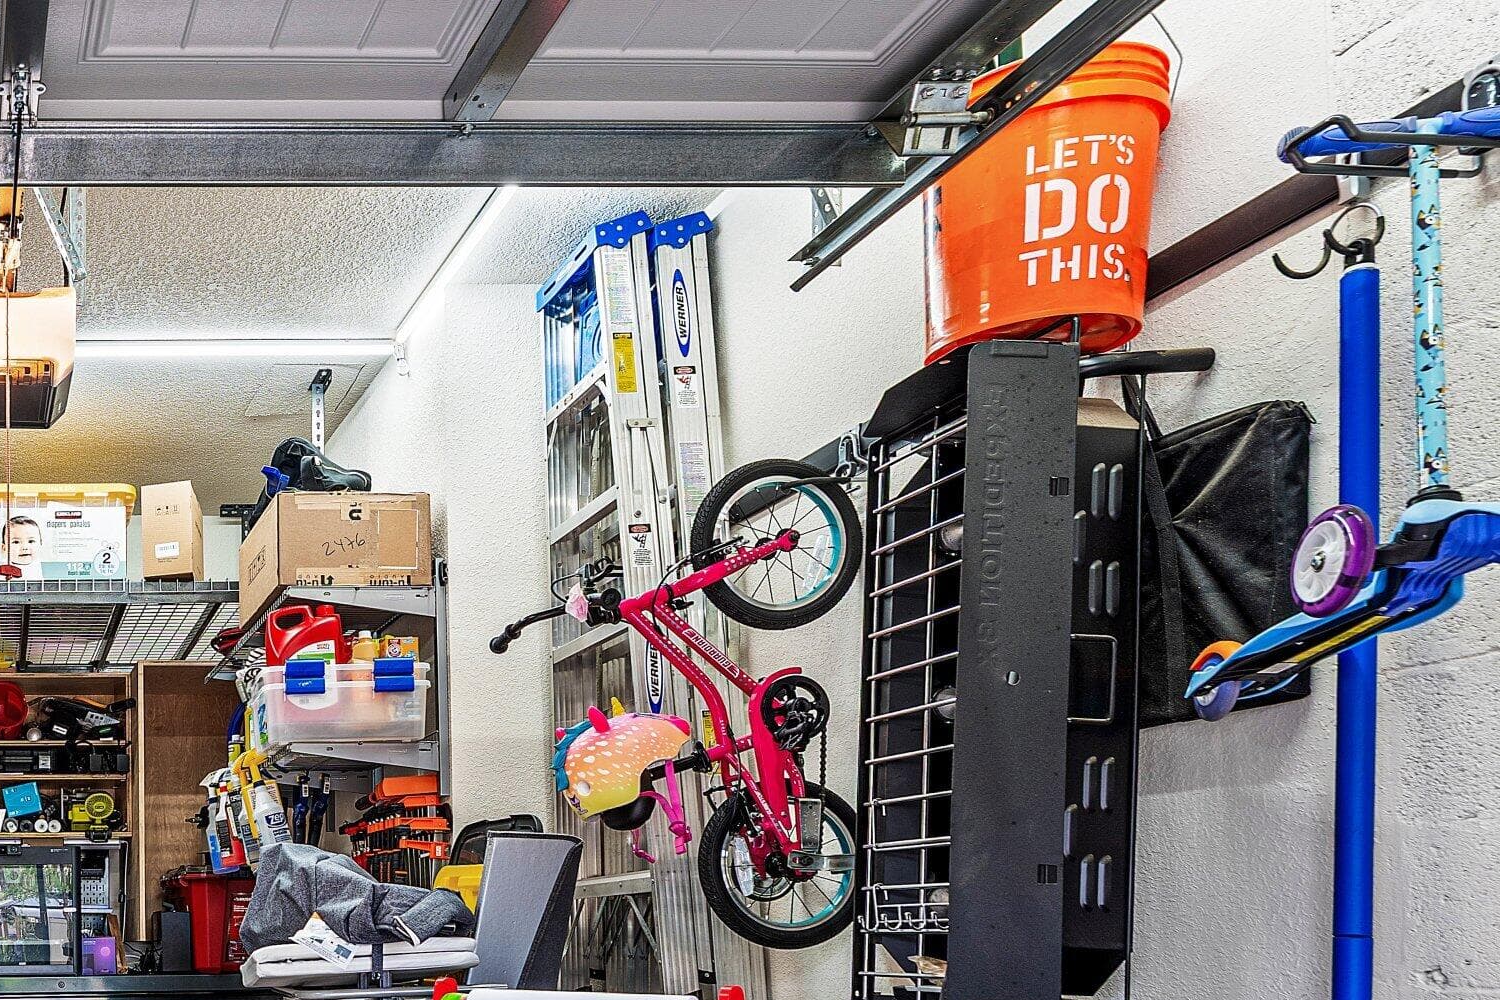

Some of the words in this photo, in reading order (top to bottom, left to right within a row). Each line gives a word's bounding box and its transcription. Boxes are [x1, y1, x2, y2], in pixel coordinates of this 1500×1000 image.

[1025, 133, 1136, 176] LET'S
[1023, 173, 1131, 245] DO
[1018, 242, 1132, 287] THIS.
[674, 286, 688, 340] WERNER
[102, 552, 111, 563] 2
[321, 533, 367, 557] 2476
[691, 632, 730, 671] GUARDIAN
[268, 813, 286, 825] zep
